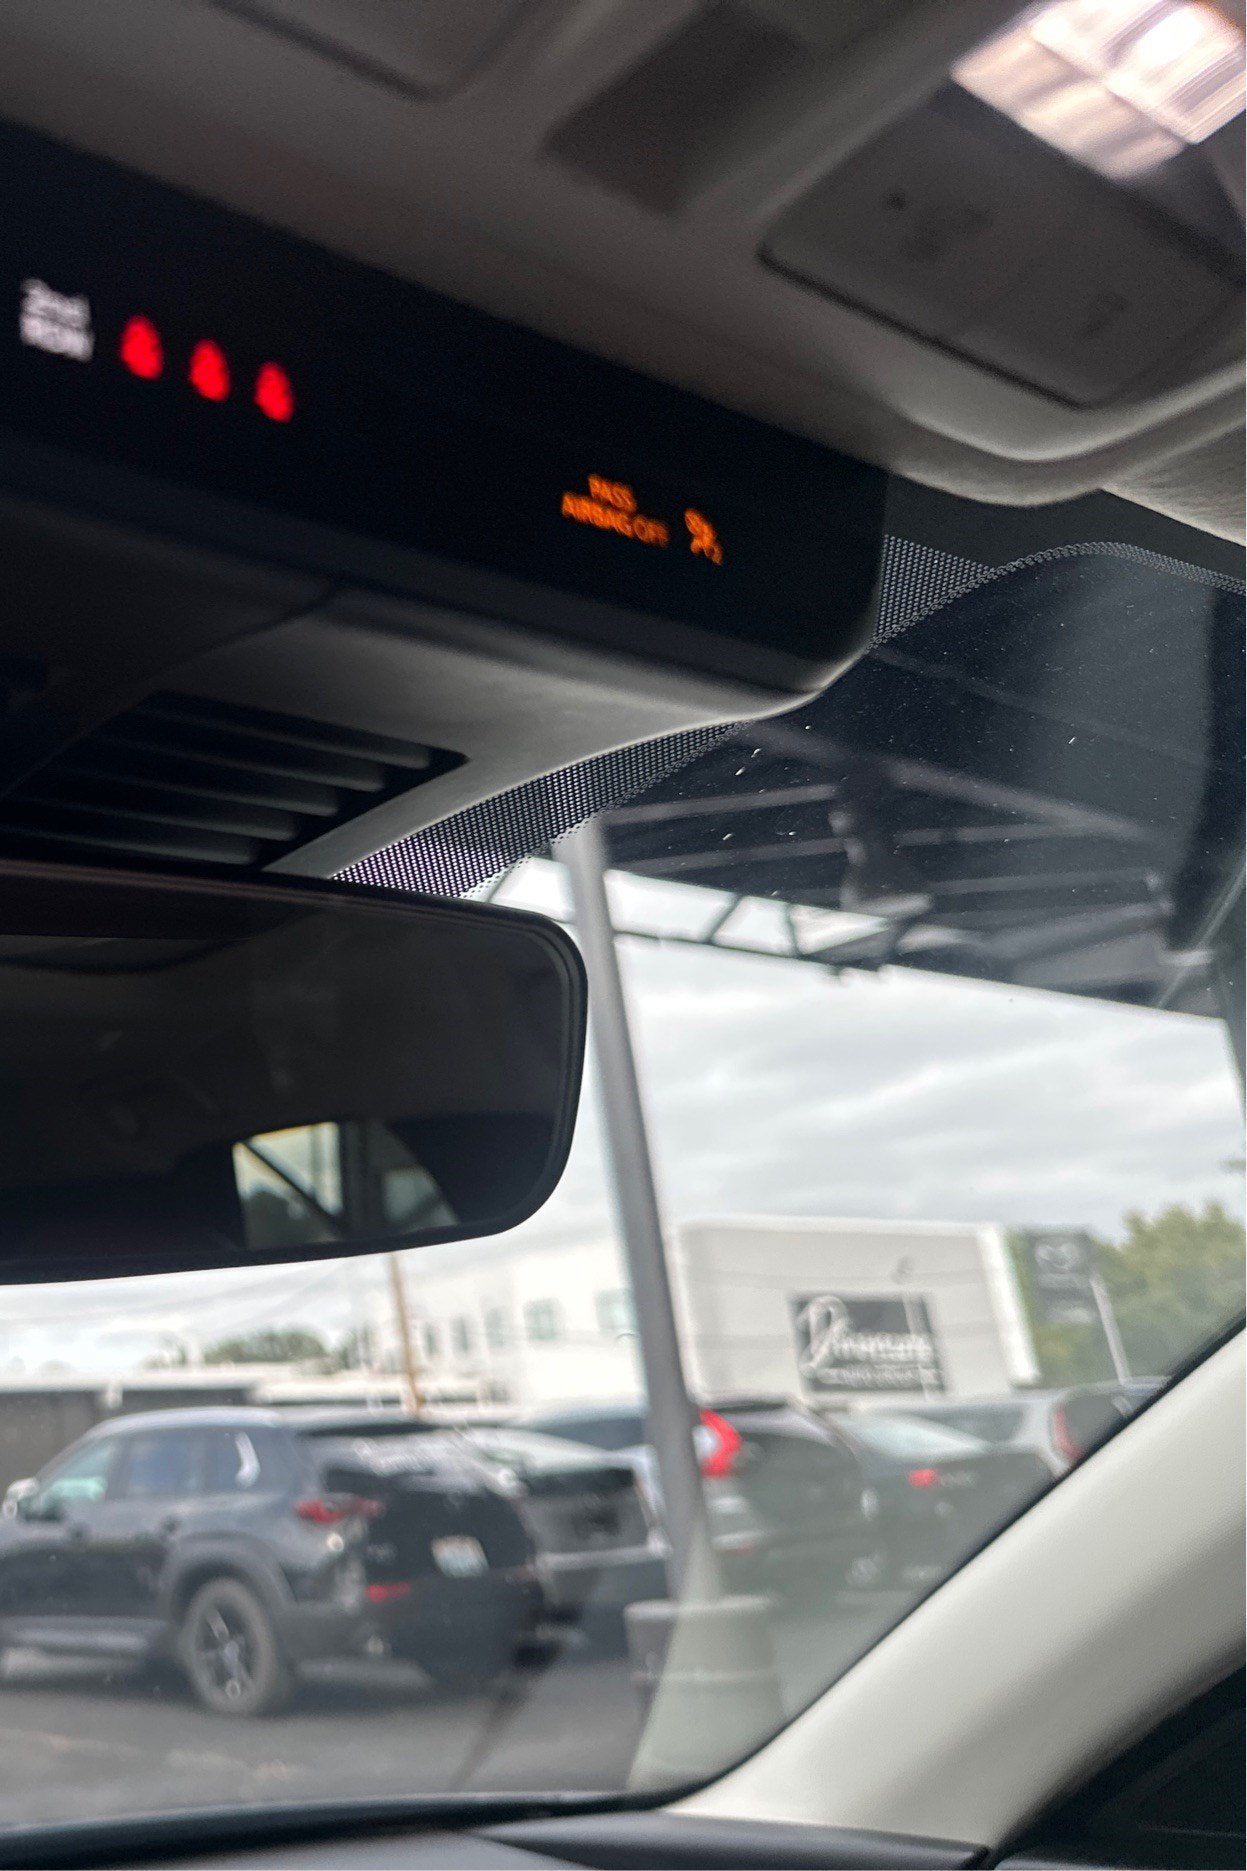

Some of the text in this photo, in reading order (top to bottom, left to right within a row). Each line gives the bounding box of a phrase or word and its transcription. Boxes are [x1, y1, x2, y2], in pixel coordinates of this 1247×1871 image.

[587, 475, 634, 514] PASS
[561, 493, 667, 543] AIRBAG OFF
